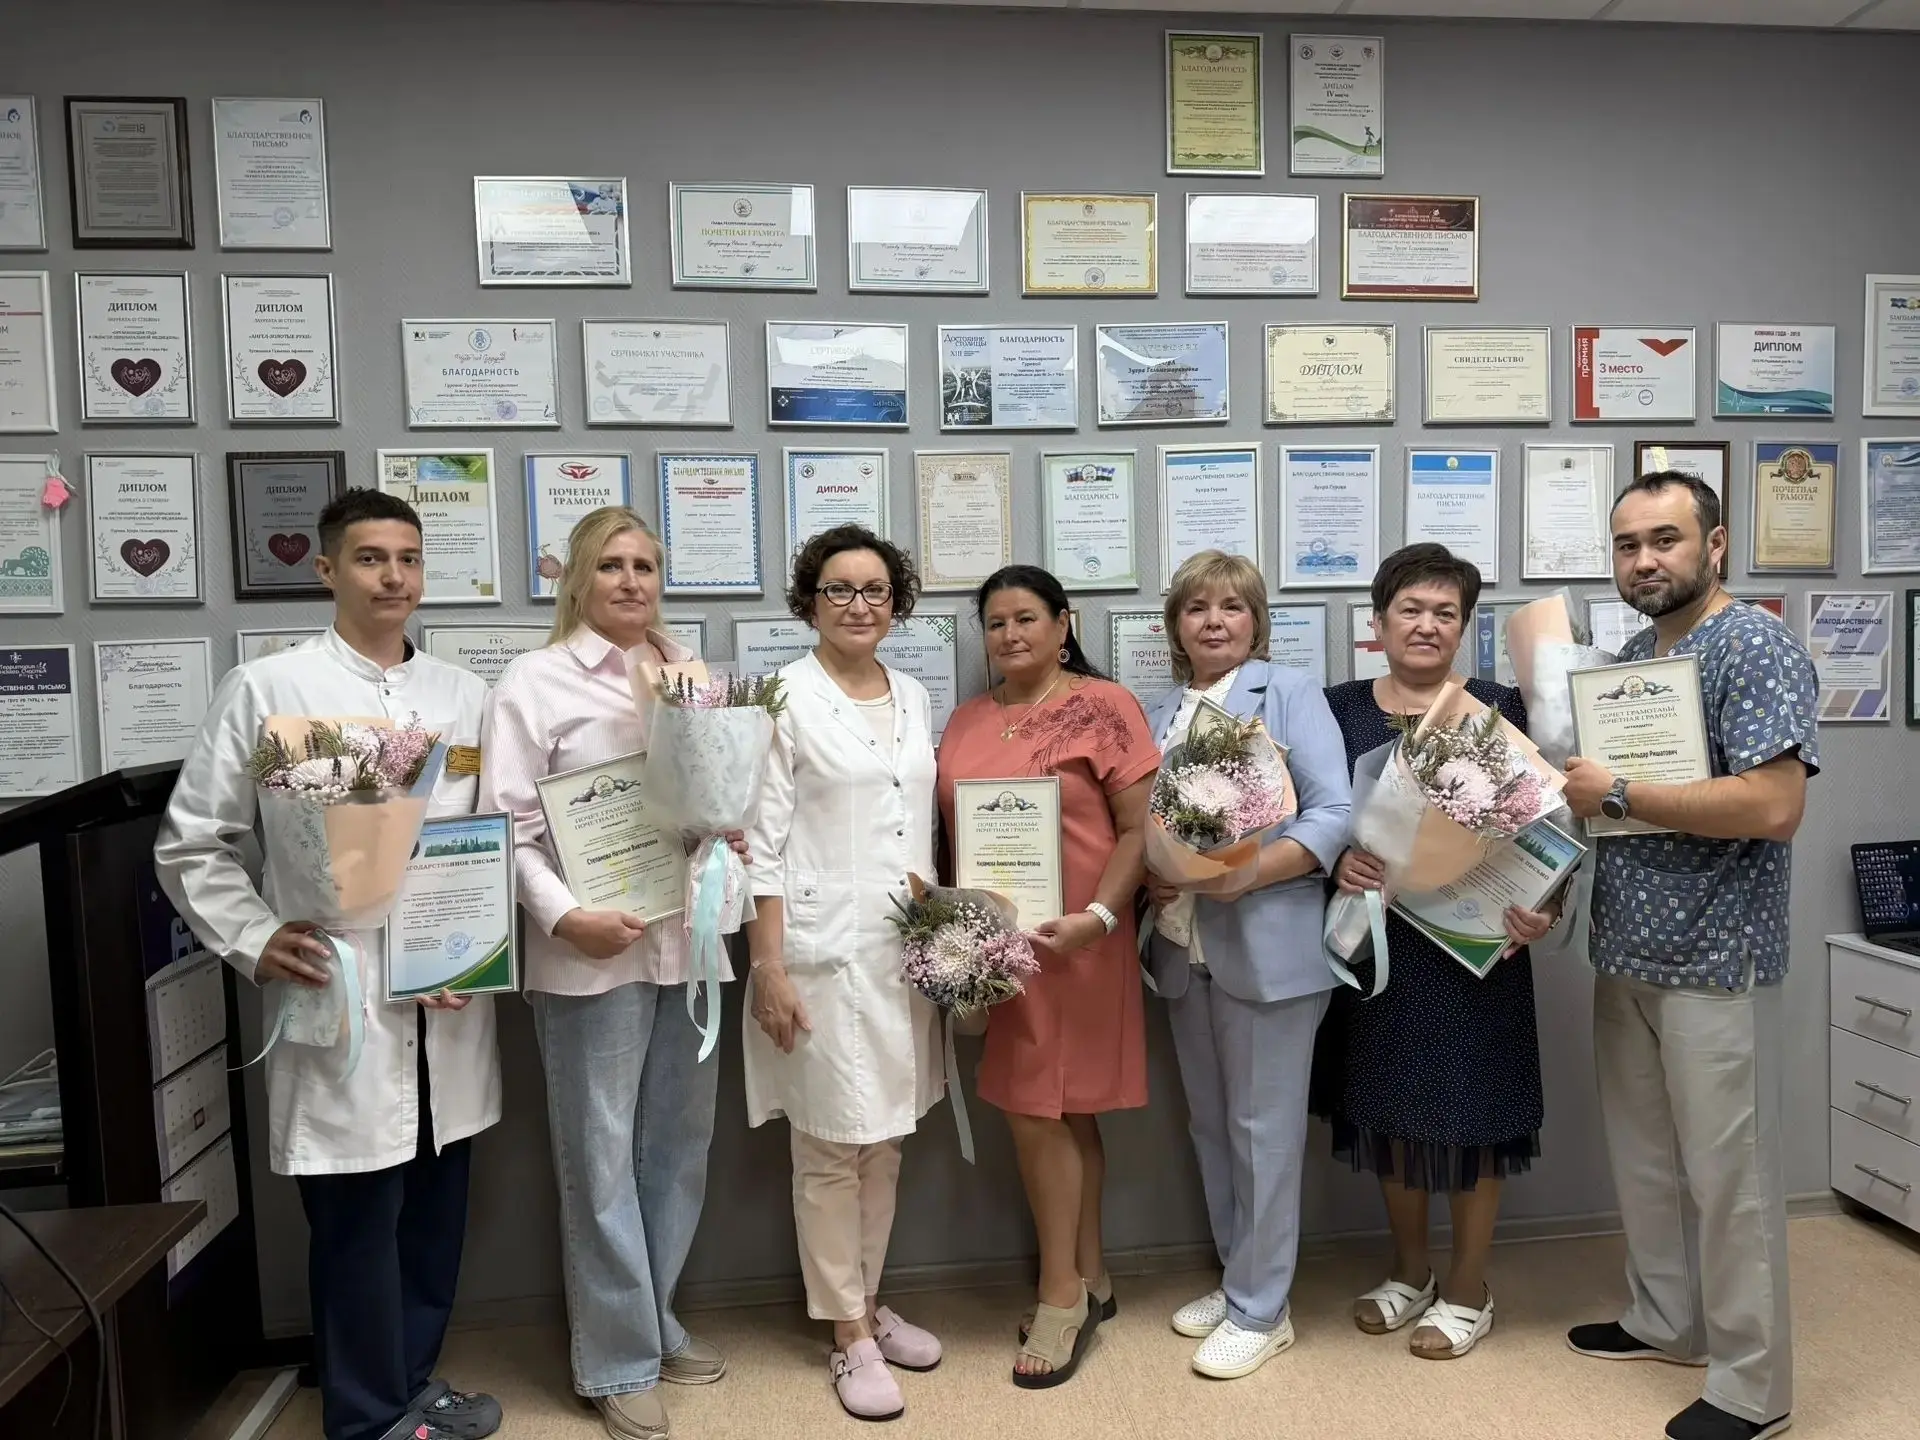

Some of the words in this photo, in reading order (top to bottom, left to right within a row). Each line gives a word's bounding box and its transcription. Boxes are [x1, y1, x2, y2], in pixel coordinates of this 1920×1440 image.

[1181, 65, 1247, 73] БЛАГОДАРНОСТЬ
[227, 131, 313, 140] БЛАГОДАРСТВЕННОЕ
[701, 228, 746, 236] ПОЧЕТНАЯ
[747, 229, 785, 238] ГРАМОТА
[1358, 231, 1433, 239] БЛАГОДАРСТВЕННОЕ
[1434, 232, 1468, 240] ПИСЬМО
[108, 303, 157, 312] ДИПЛОМ
[255, 304, 303, 313] ДИПЛОМ
[1754, 342, 1802, 352] ДИПЛОМ
[611, 349, 660, 357] СЕРТИФИКАТ
[661, 350, 704, 358] УЧАСТНИКА
[1581, 337, 1590, 378] премия
[442, 368, 520, 376] БЛАГОДАРНОСТЬ
[1300, 363, 1363, 376] ДИПЛОМ
[1599, 363, 1607, 373] 3
[1608, 365, 1643, 373] место
[118, 483, 167, 493] ДИПЛОМ
[265, 486, 307, 495] ДИПЛОМ
[548, 488, 610, 496] ПОЧЕТНАЯ
[816, 485, 858, 494] ДИПЛОМ
[1776, 493, 1814, 501] ГРАМОТА
[458, 648, 498, 656] European
[1599, 716, 1640, 725] ПОЧЕТНАЯ
[1641, 712, 1678, 721] ГРАМОТА
[1600, 711, 1624, 719] ПОЧЕТ
[1608, 753, 1630, 761] Каримов
[1630, 751, 1649, 759] Ильдар
[1650, 749, 1678, 757] Ришатович
[575, 815, 615, 830] ПОЧЕТНАЯ
[616, 805, 646, 819] ГРАМОТ
[575, 812, 599, 824] ПОЧЕТ
[586, 853, 612, 865] Степанова
[612, 847, 631, 857] Наталья
[631, 838, 658, 851] Викторовна
[406, 860, 469, 872] АГОДАРСТВЕННОЕ
[471, 857, 501, 865] ПИСЬМО
[1525, 861, 1550, 880] ПИСЬМО
